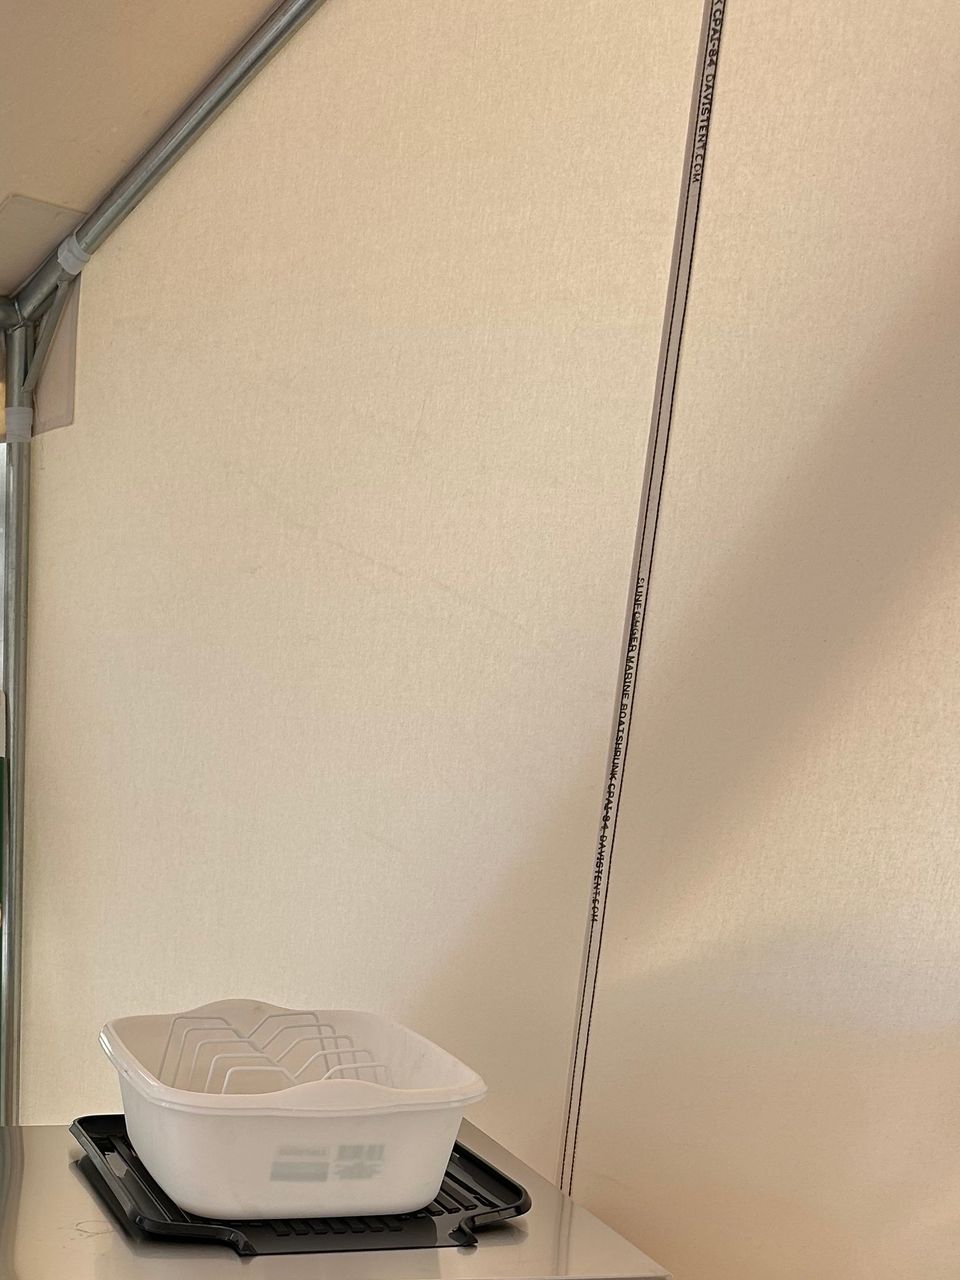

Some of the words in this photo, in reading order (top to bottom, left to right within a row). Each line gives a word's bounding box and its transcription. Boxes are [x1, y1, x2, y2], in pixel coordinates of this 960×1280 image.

[707, 9, 722, 67] CPAI-84
[692, 74, 715, 183] DAVISTENT.COM
[622, 656, 637, 700] MARINE
